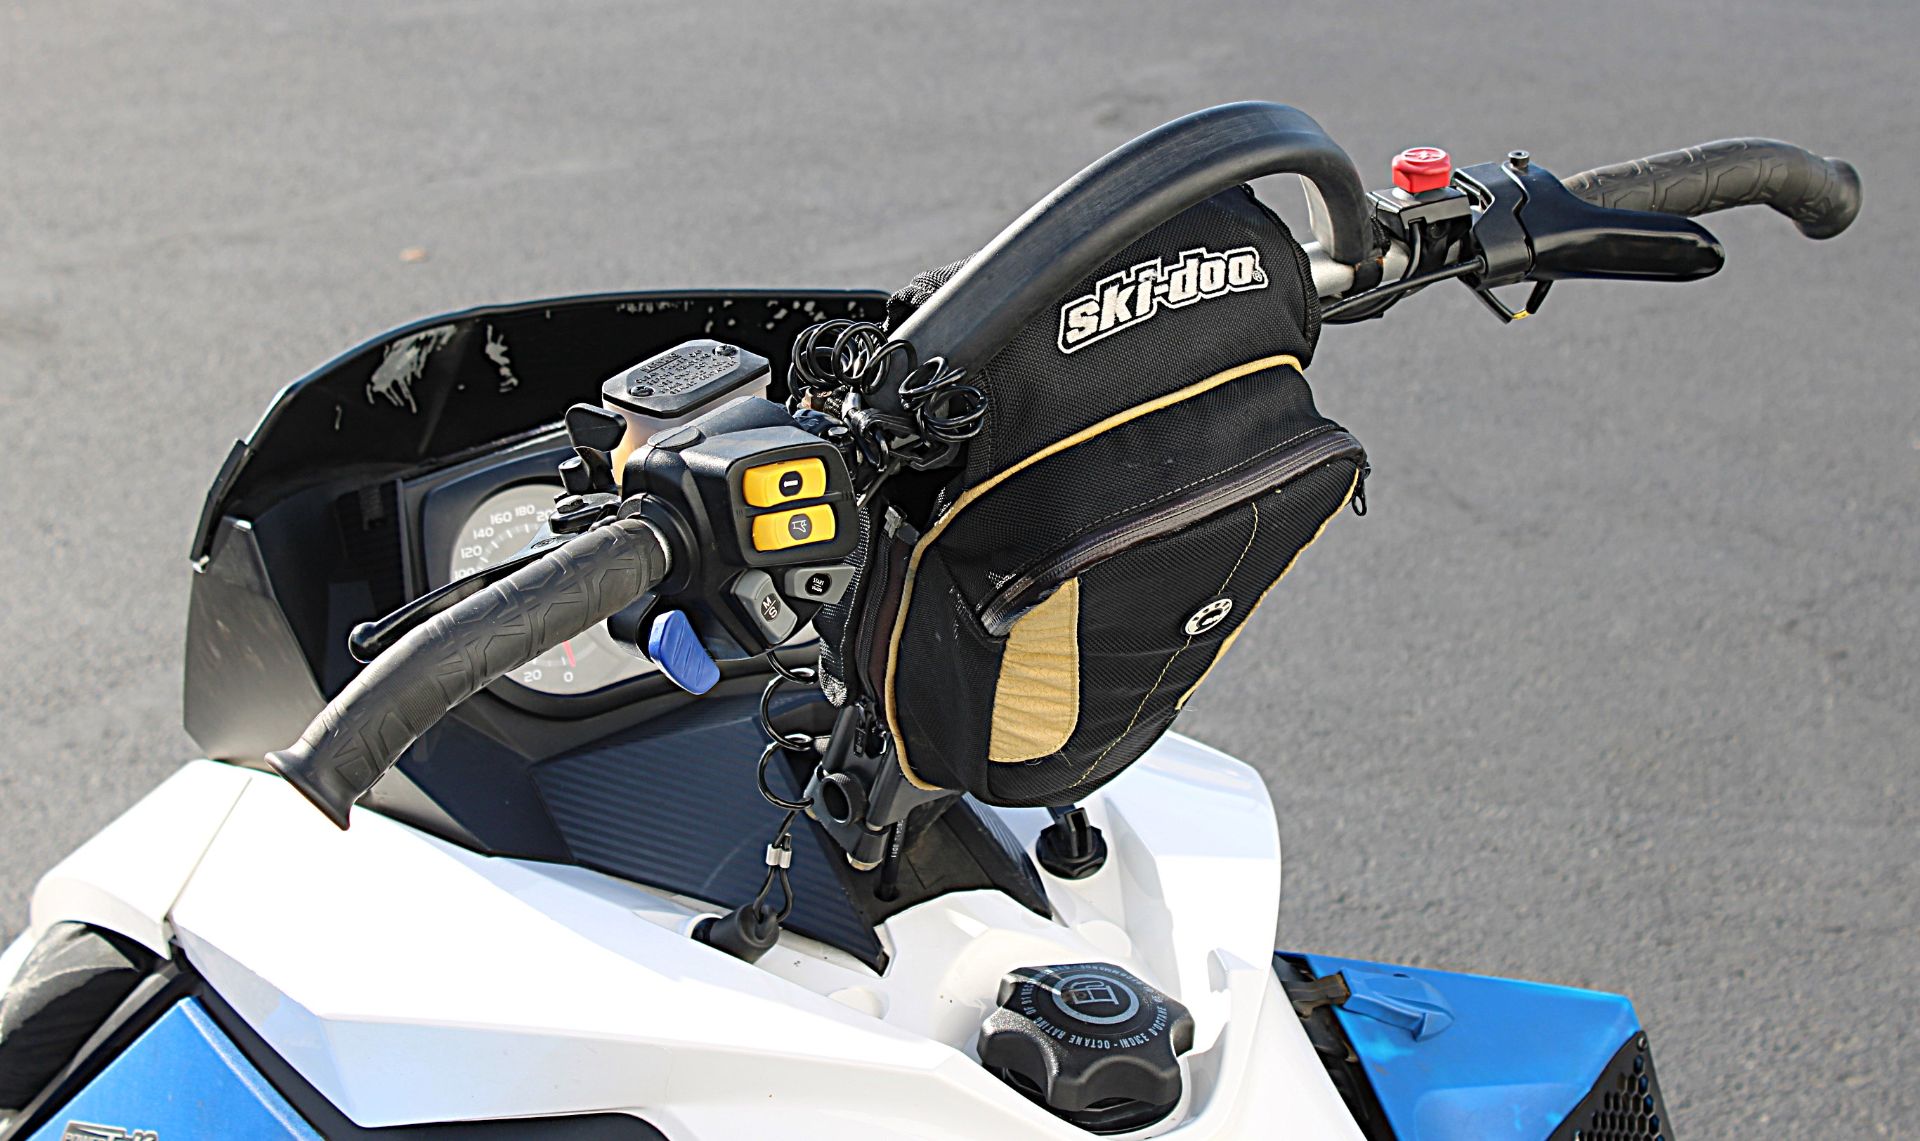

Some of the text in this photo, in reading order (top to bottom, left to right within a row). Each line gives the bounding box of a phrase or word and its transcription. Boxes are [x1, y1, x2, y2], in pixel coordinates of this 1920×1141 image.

[514, 504, 536, 517] 180
[536, 508, 554, 522] 20
[490, 511, 513, 525] 160
[473, 527, 494, 540] 140
[461, 545, 482, 559] 120
[523, 669, 574, 683] 20 0
[1033, 1016, 1066, 1040] RATING
[1068, 1034, 1111, 1049] OCTANE
[1119, 1032, 1150, 1049] INDICE
